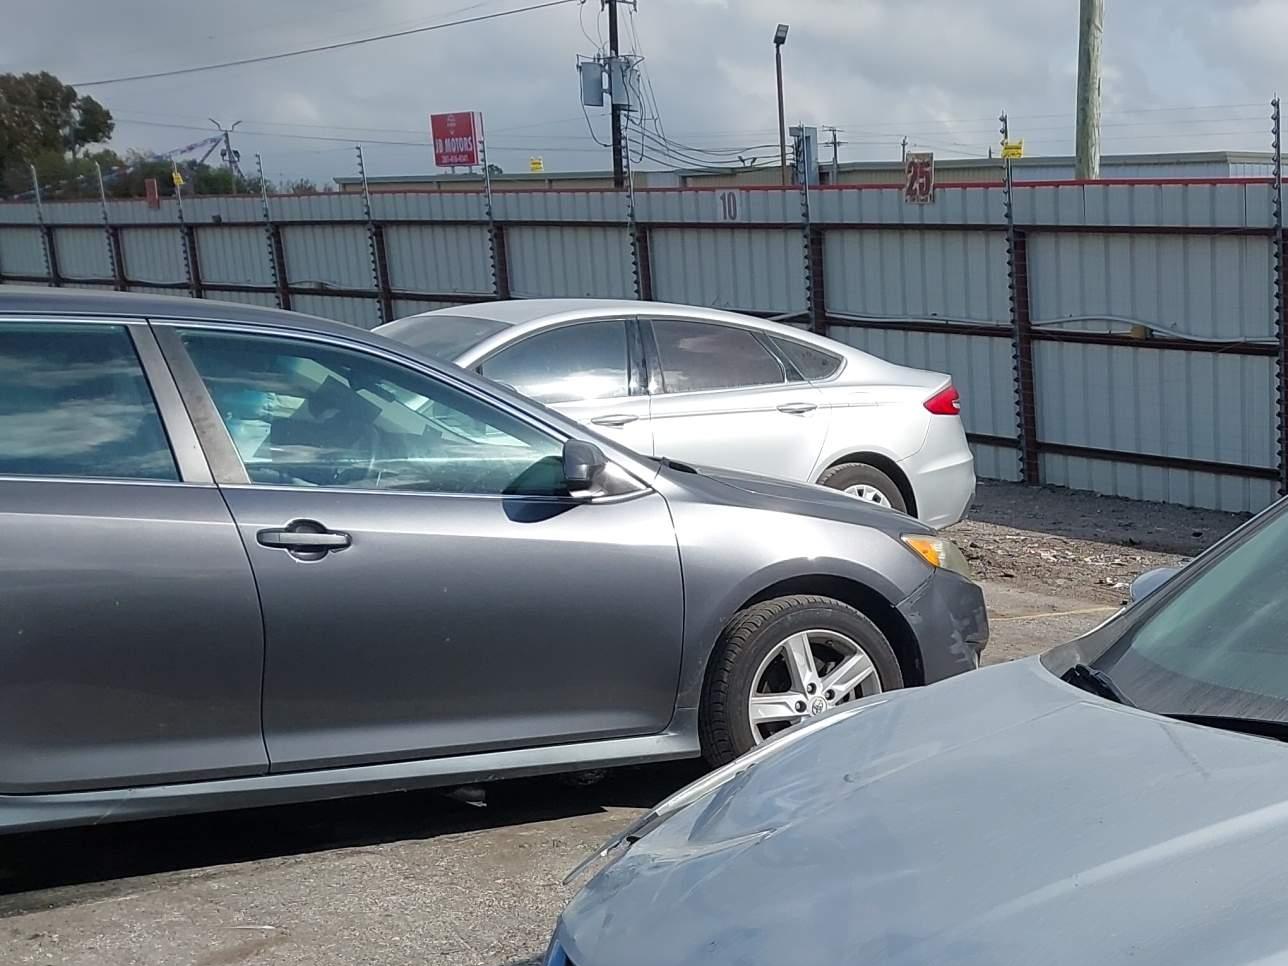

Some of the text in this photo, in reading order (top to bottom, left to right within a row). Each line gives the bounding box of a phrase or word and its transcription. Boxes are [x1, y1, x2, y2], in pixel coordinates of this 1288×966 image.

[444, 136, 472, 152] MOTORS
[905, 160, 931, 198] 25
[719, 191, 737, 220] 10
